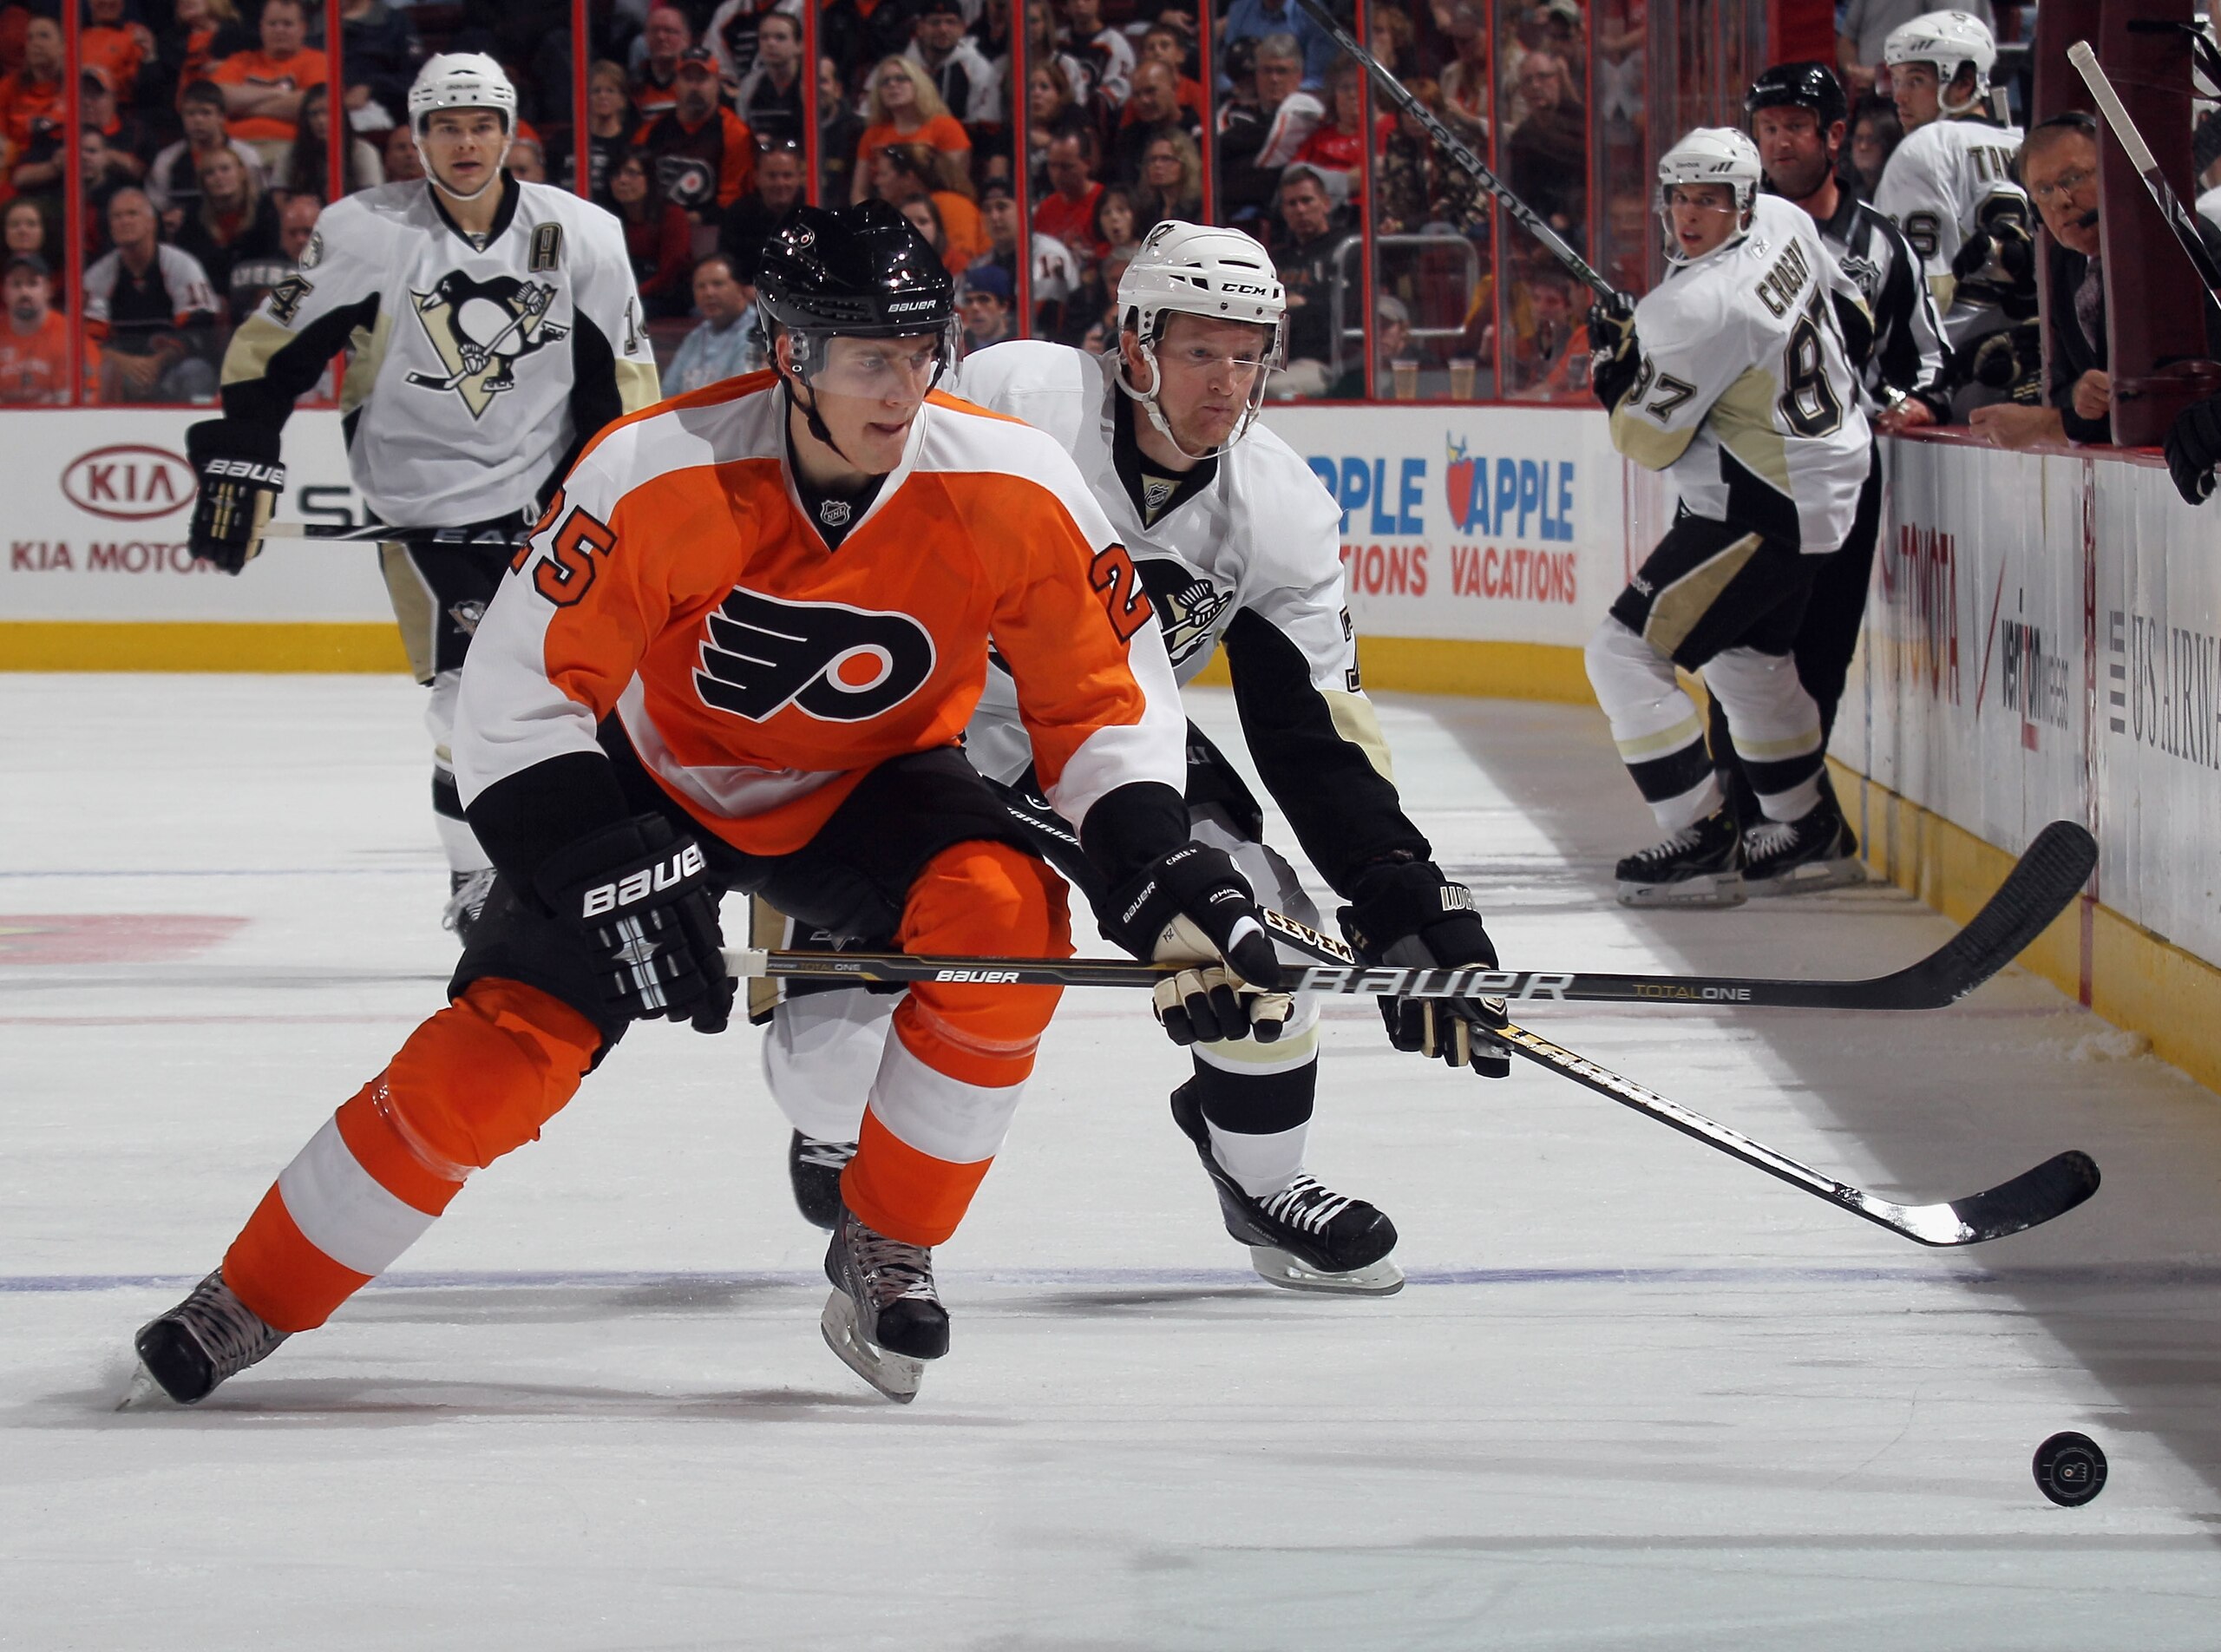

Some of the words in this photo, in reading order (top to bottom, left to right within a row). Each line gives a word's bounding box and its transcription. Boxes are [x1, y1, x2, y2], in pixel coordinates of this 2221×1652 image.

[527, 221, 563, 272] A
[1222, 283, 1267, 296] CCM
[1754, 236, 1810, 319] CROSBY
[888, 299, 937, 313] BAUER
[88, 463, 176, 502] KIA
[205, 459, 285, 486] BAUE
[1463, 456, 1576, 542] APPLE
[10, 541, 74, 574] KIA
[87, 541, 223, 574] MOTO
[1339, 543, 1429, 598] TIONS
[1450, 545, 1577, 606] VACATIONS
[1122, 880, 1156, 924] BAUER
[1263, 908, 1355, 965] SEVEN
[935, 969, 1021, 985] BAUER
[1297, 967, 1575, 1000] BAUER
